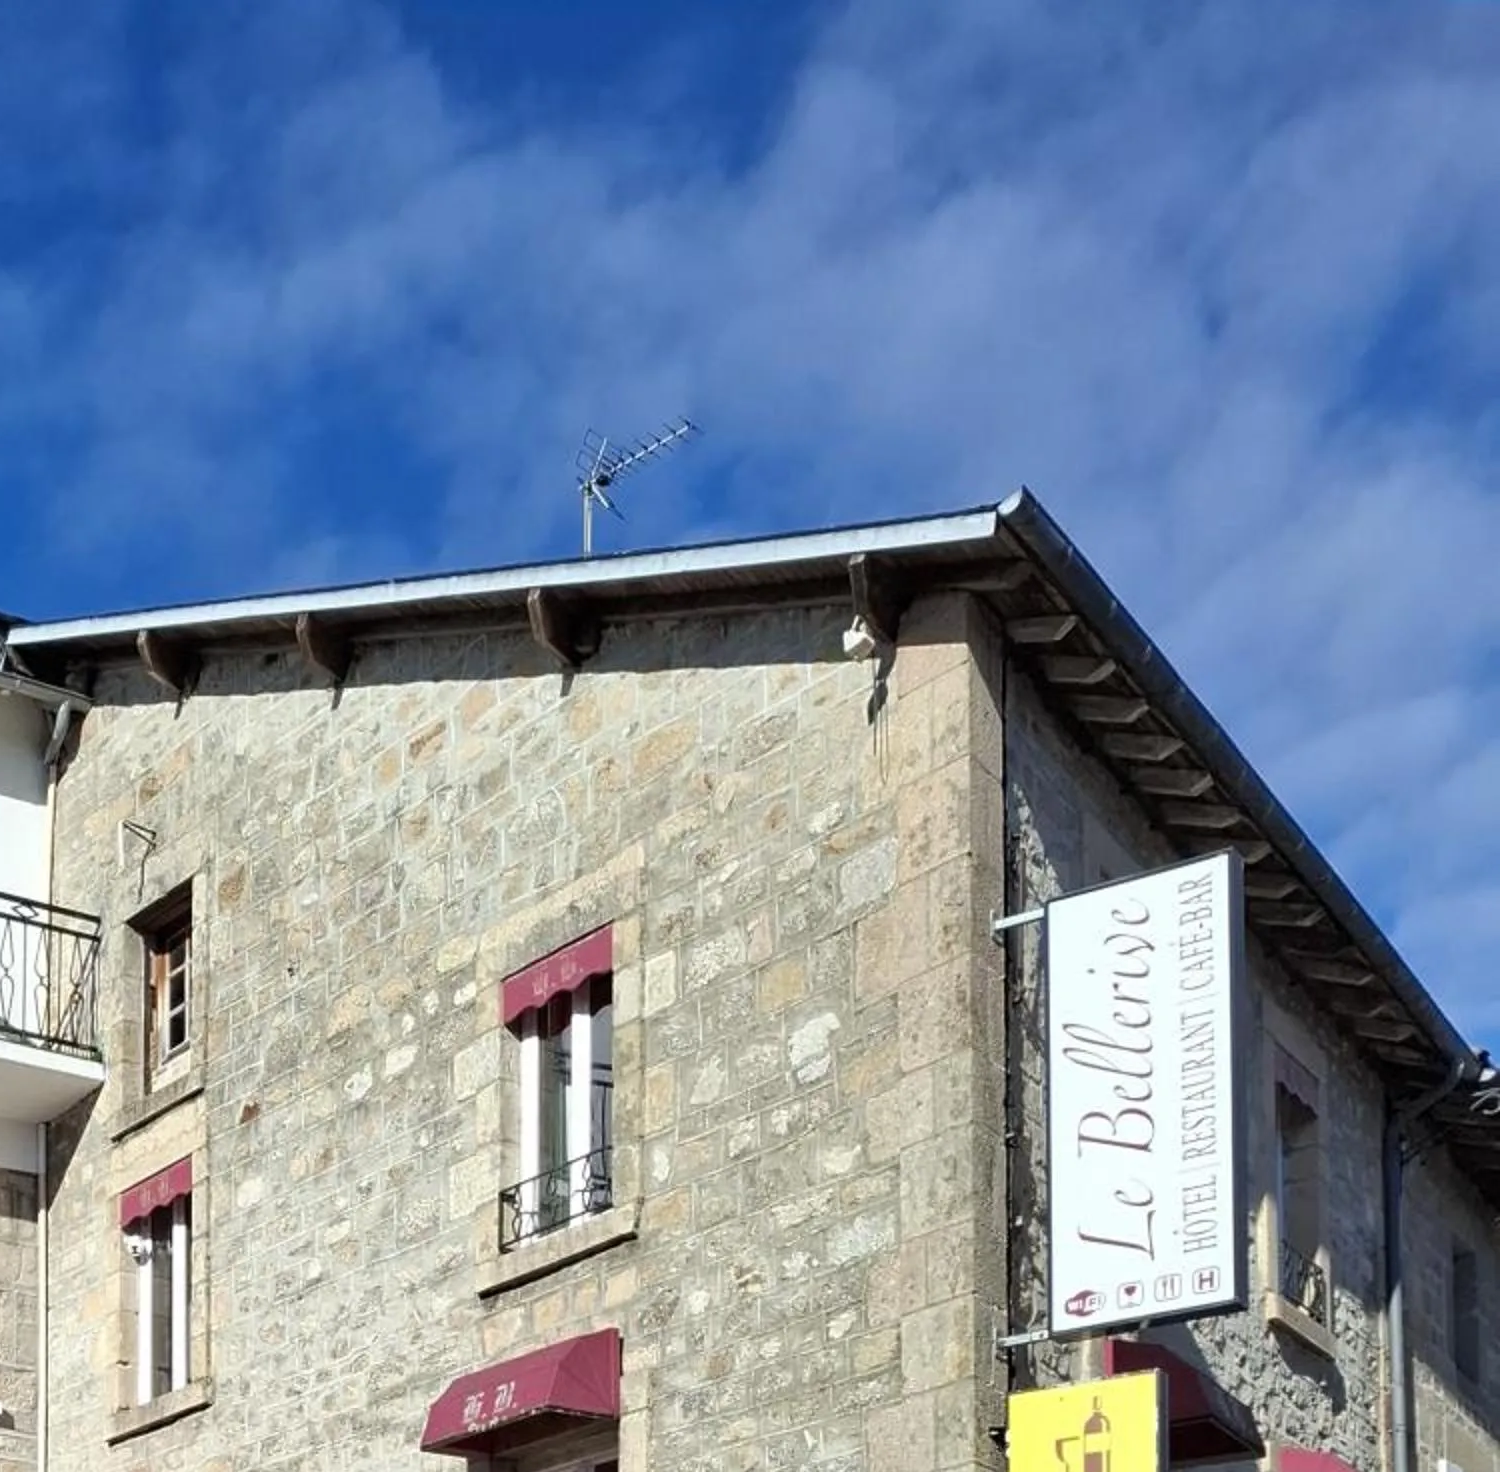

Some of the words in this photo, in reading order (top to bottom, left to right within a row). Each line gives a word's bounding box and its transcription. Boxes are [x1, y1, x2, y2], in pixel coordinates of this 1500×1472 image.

[1061, 897, 1156, 1159] Bellerive
[1180, 1008, 1218, 1162] RESTAURANT
[1076, 1177, 1156, 1262] Le
